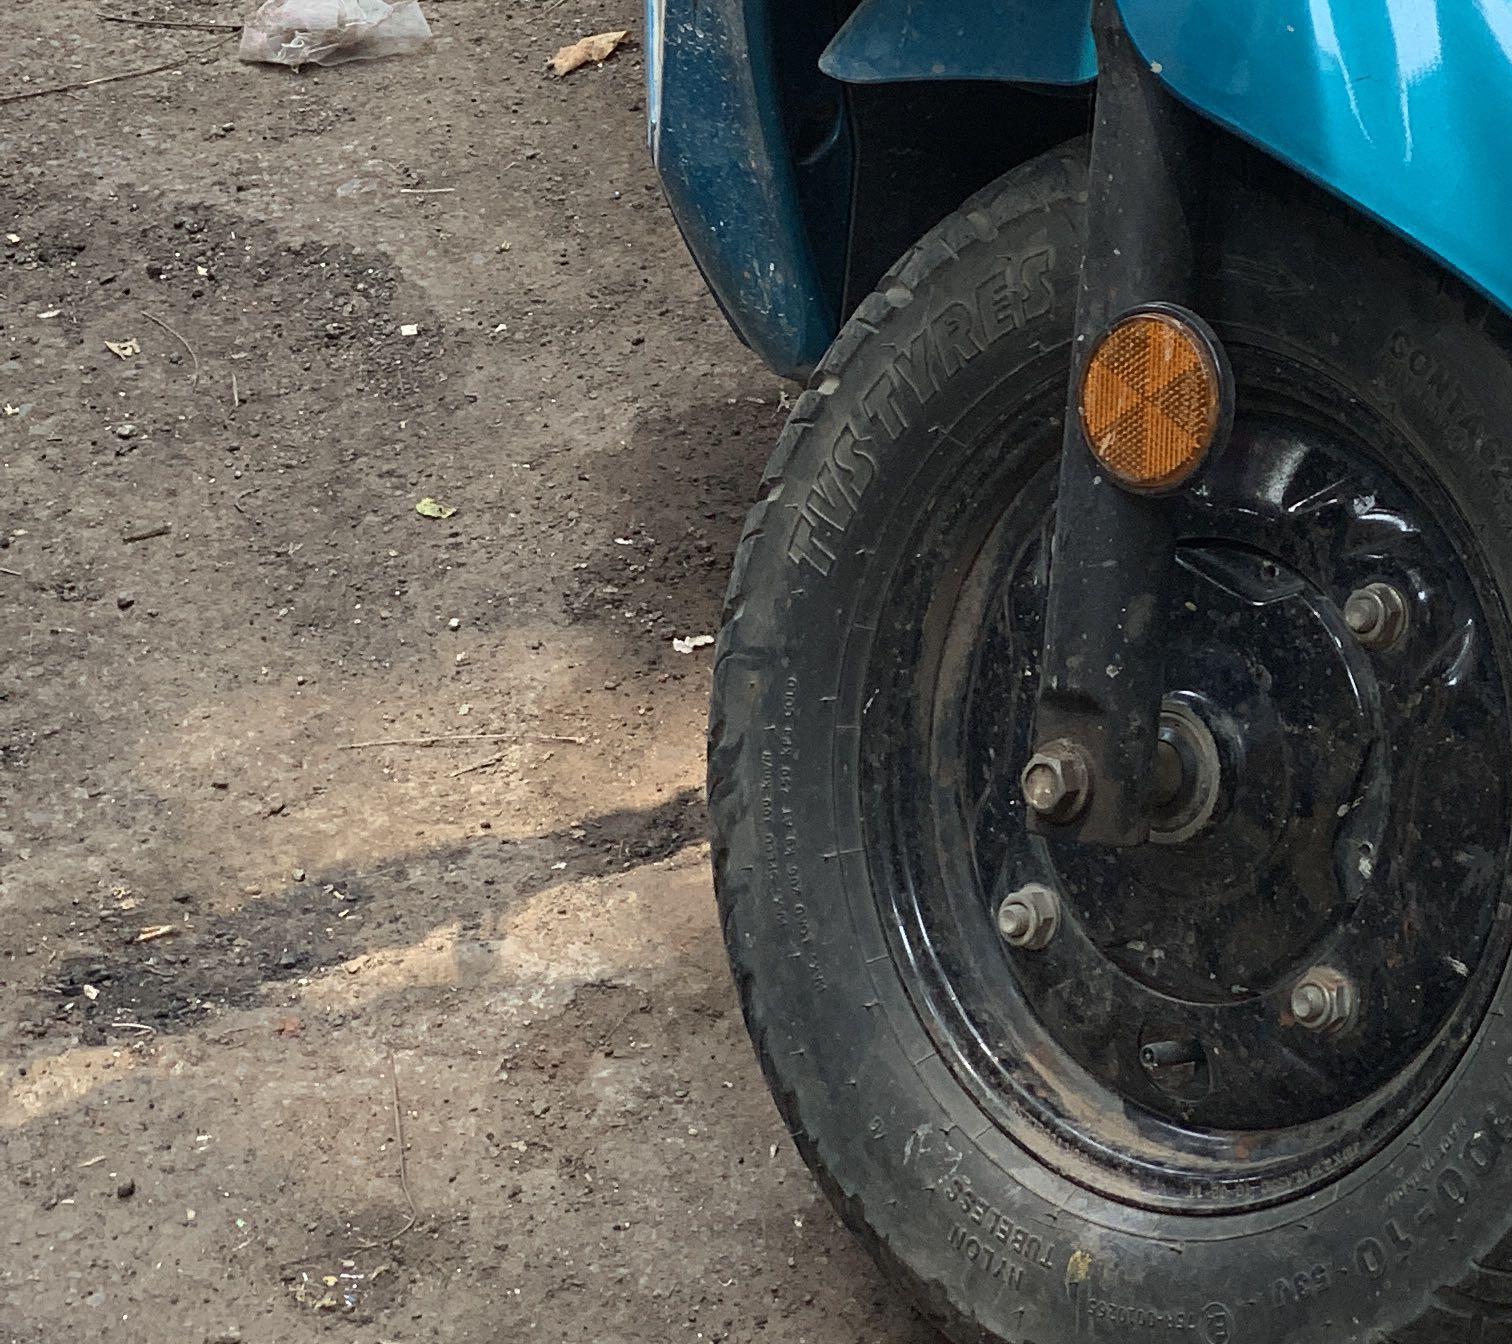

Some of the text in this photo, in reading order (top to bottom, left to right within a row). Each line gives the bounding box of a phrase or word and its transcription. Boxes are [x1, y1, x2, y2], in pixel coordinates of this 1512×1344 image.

[787, 246, 1054, 576] TVS TYRES
[944, 1176, 1056, 1270] TUBELESS
[948, 1223, 1024, 1292] NYLON
